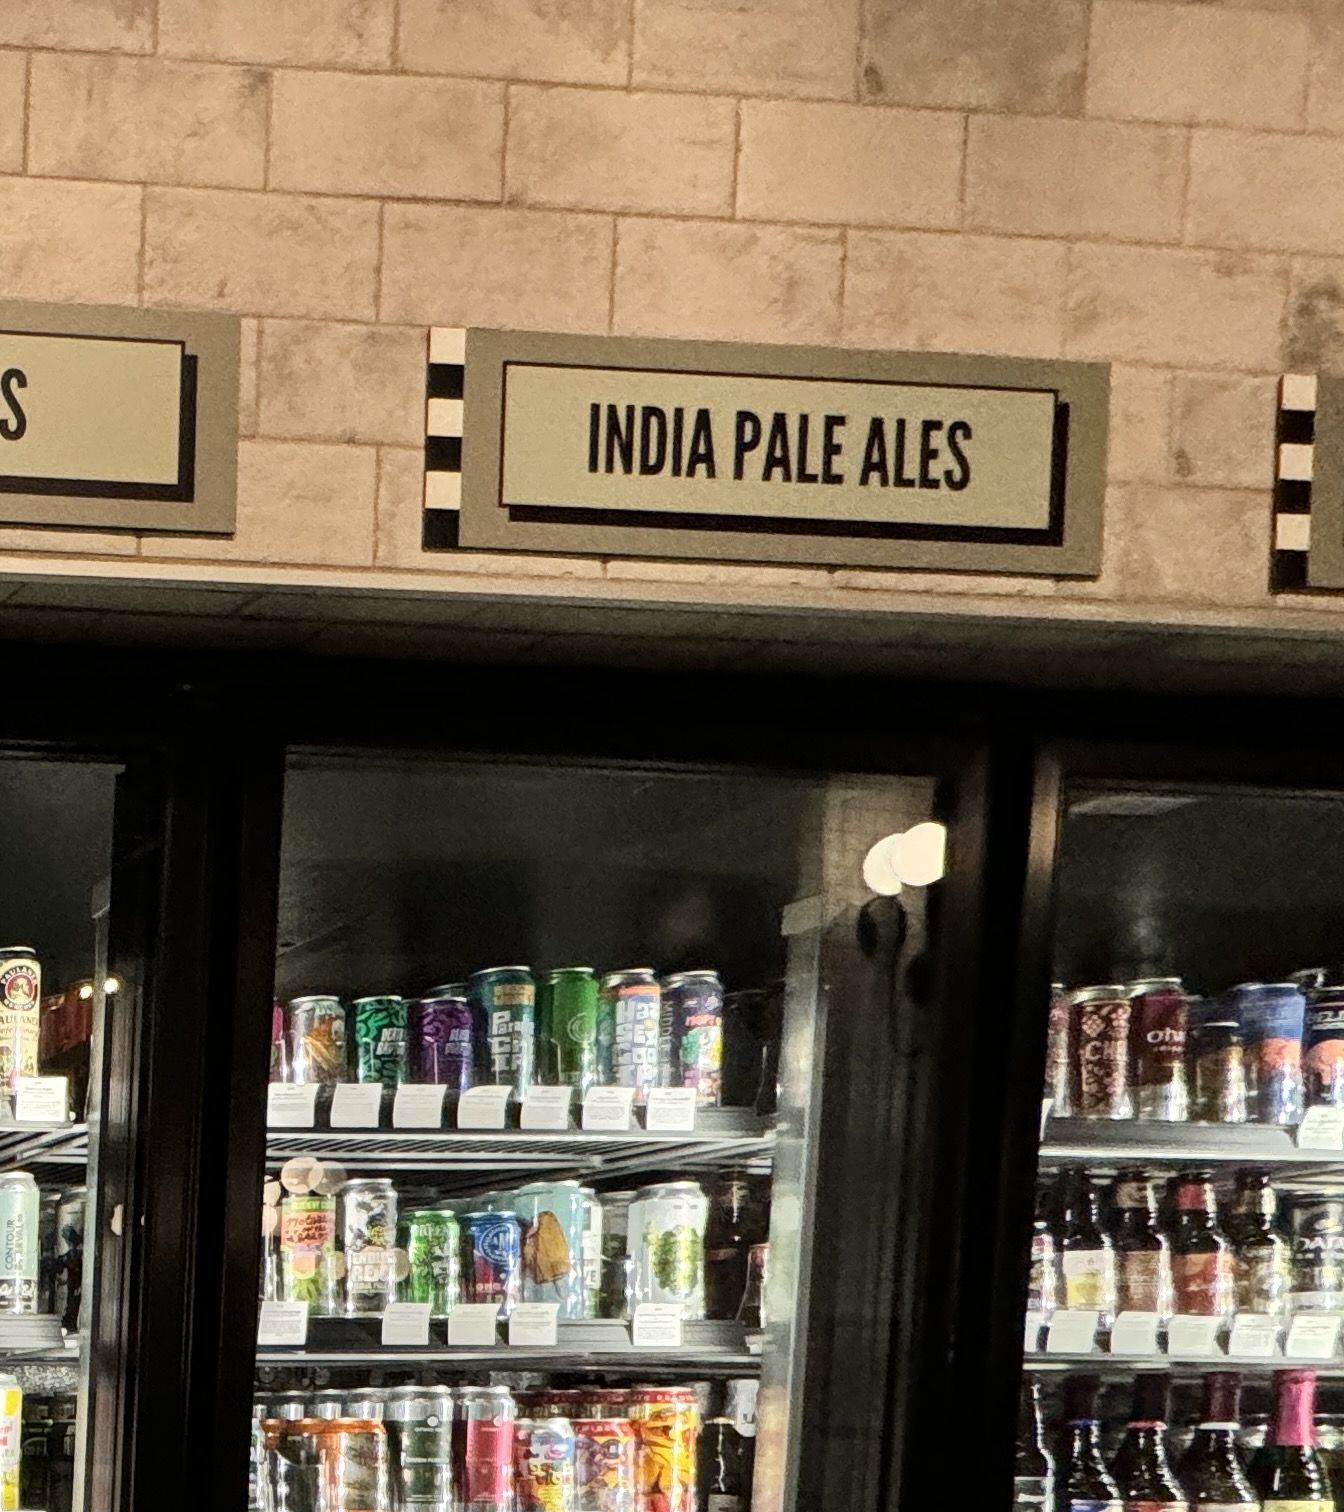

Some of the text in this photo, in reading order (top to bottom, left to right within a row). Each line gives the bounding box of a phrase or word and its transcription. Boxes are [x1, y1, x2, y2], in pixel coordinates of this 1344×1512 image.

[588, 402, 973, 492] INDIA PALE ALES
